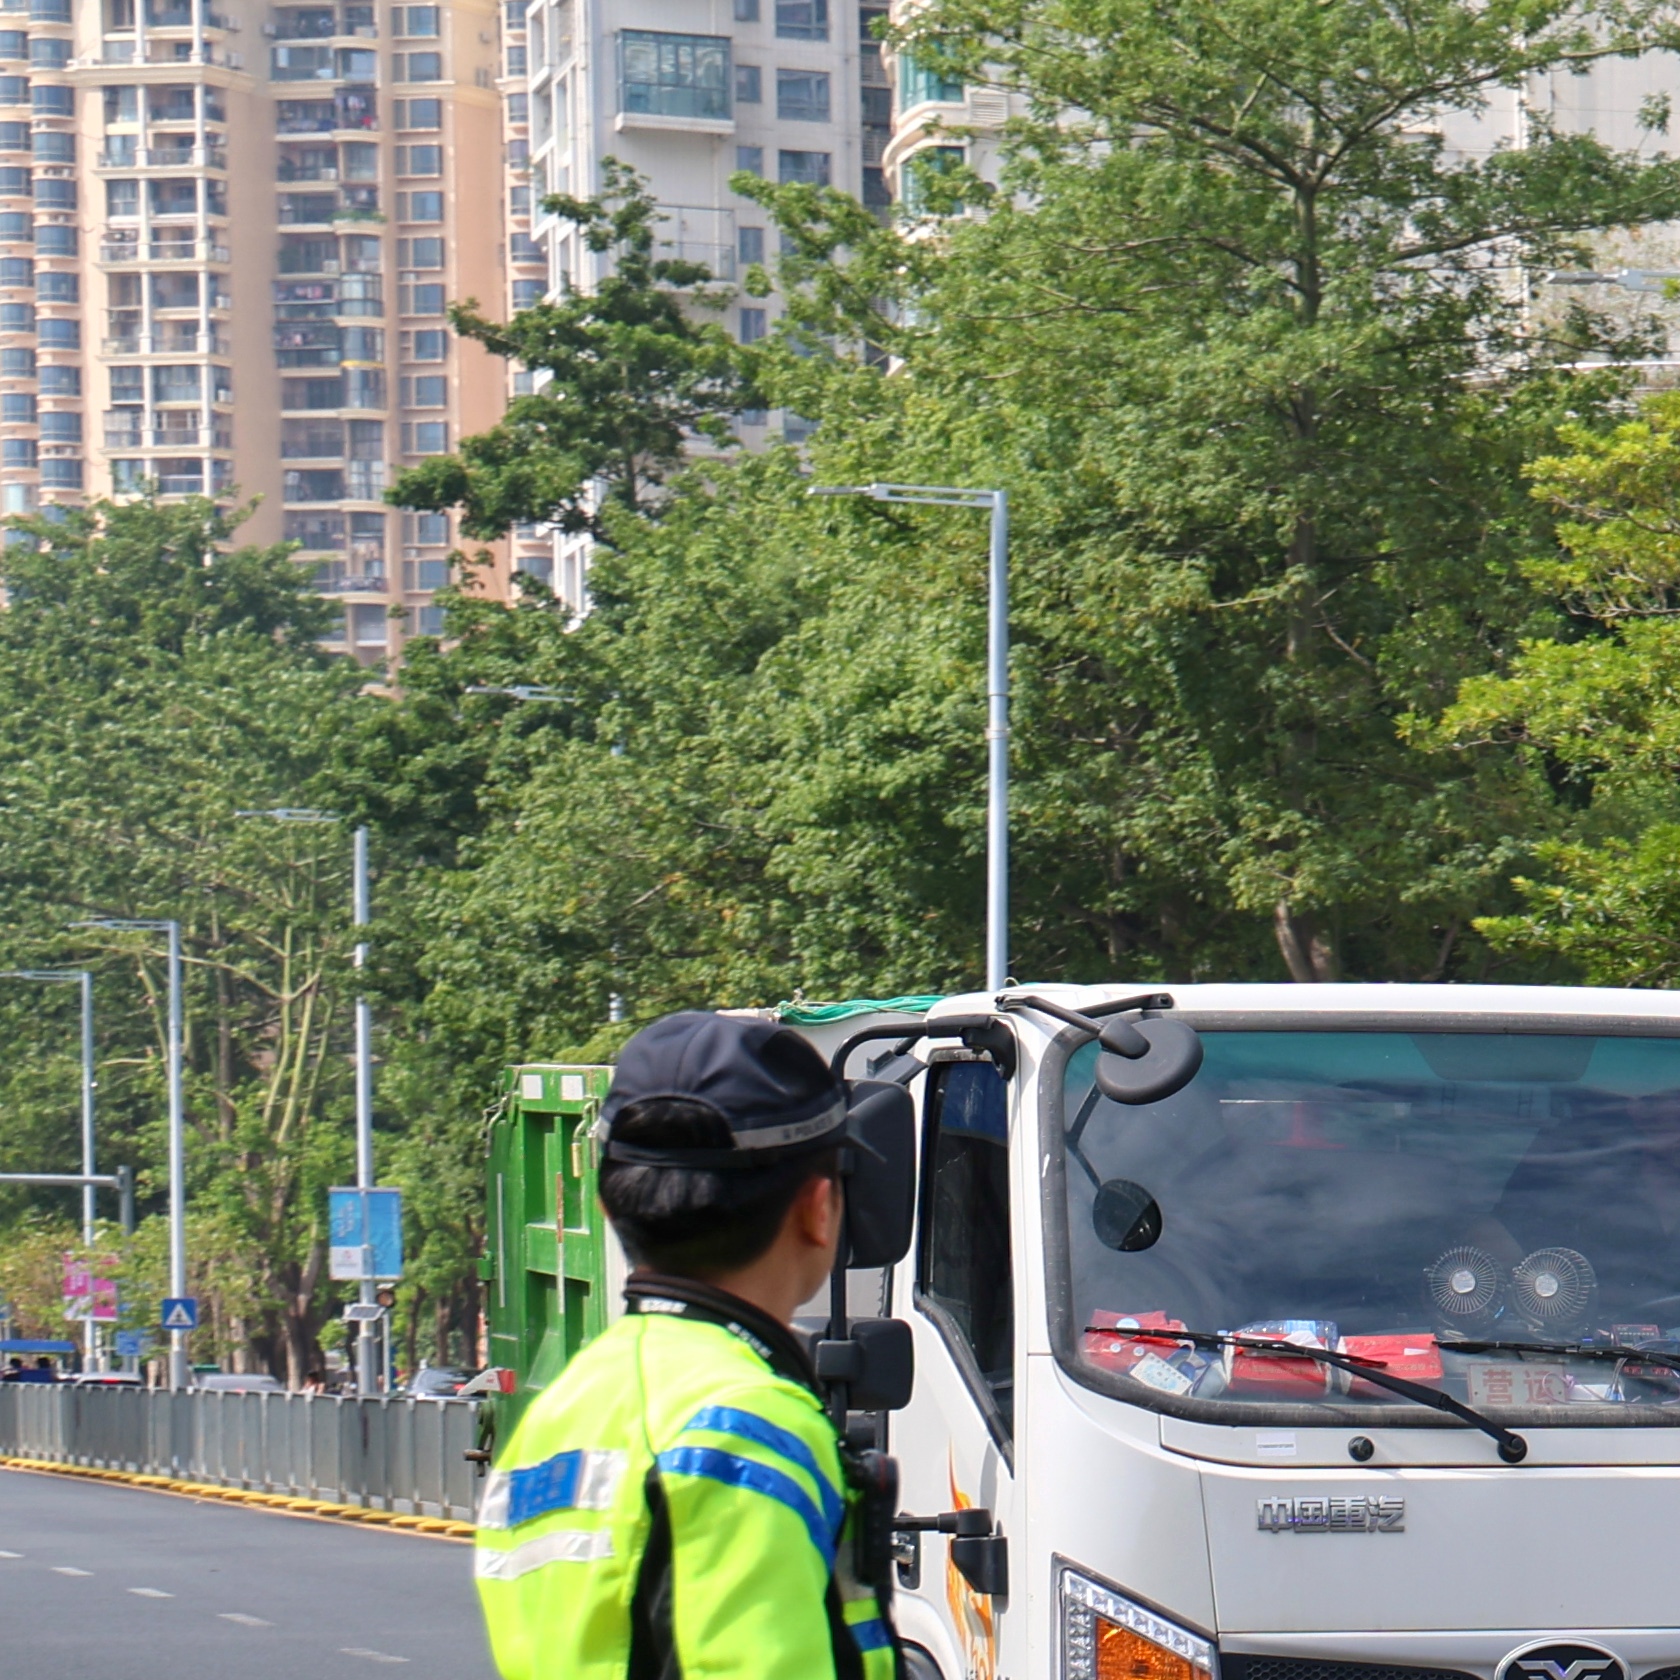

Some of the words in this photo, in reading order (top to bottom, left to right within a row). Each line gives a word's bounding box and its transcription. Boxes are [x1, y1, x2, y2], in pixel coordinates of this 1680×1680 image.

[1483, 1369, 1554, 1404] 营运
[1257, 1496, 1404, 1533] 中国重汽
